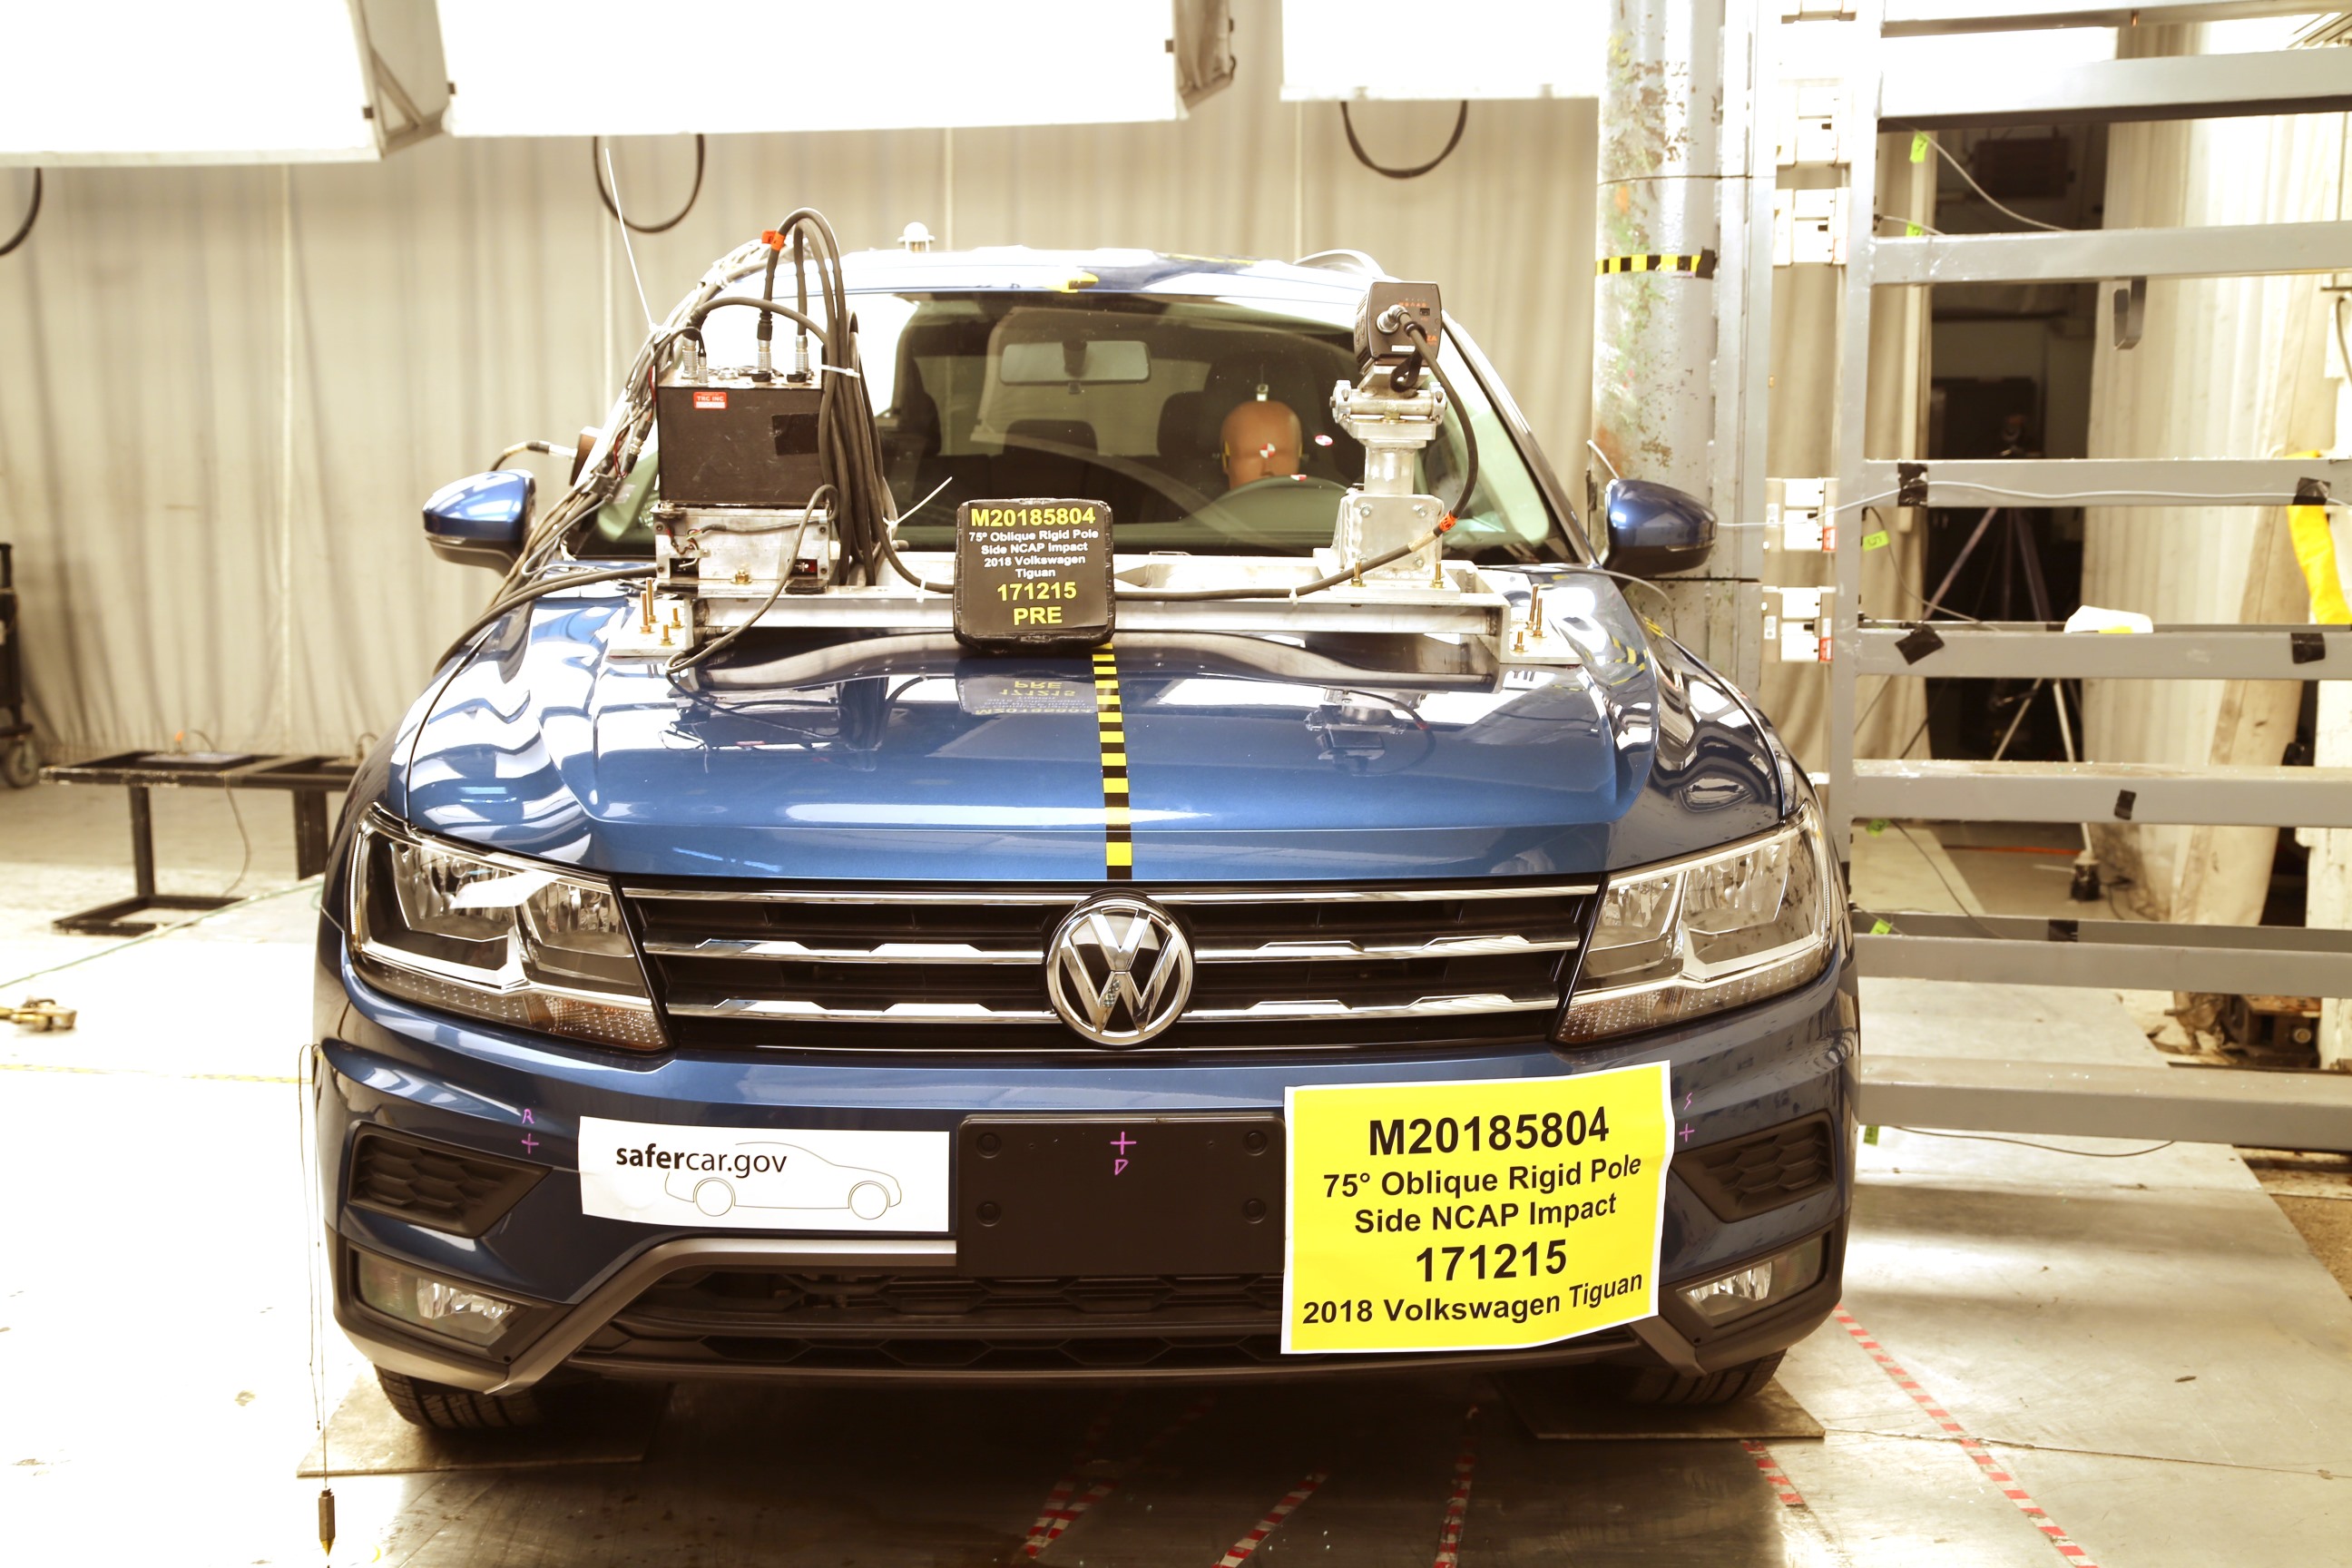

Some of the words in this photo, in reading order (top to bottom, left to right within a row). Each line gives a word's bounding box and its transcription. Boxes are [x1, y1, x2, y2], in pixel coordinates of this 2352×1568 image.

[971, 507, 1096, 527] M20185804
[990, 532, 1036, 543] Oblique
[1039, 530, 1070, 542] Rigid
[1073, 528, 1099, 539] Pole
[981, 544, 1007, 555] Side
[1010, 543, 1045, 554] NCAP
[1048, 542, 1088, 554] Impact
[984, 556, 1012, 568] 2018
[1014, 554, 1086, 566] Volkswagen
[1015, 568, 1056, 580] Tiguan
[997, 582, 1077, 601] 171215
[1014, 606, 1063, 625] PRE
[522, 1108, 535, 1124] R
[1369, 1106, 1610, 1156] M20185804
[616, 1143, 788, 1179] safercar.gov
[1323, 1172, 1371, 1198] 75°
[1381, 1171, 1498, 1199] Oblique
[1509, 1161, 1582, 1195] Rigid
[1591, 1154, 1642, 1181] Pole
[1354, 1206, 1421, 1233] Side
[1432, 1202, 1520, 1230] NCAP
[1529, 1192, 1617, 1229] Impact
[1416, 1239, 1567, 1283] 171215
[1302, 1299, 1373, 1324] 2018
[1383, 1293, 1560, 1324] Volkswagen
[1569, 1273, 1642, 1309] Tiguan
